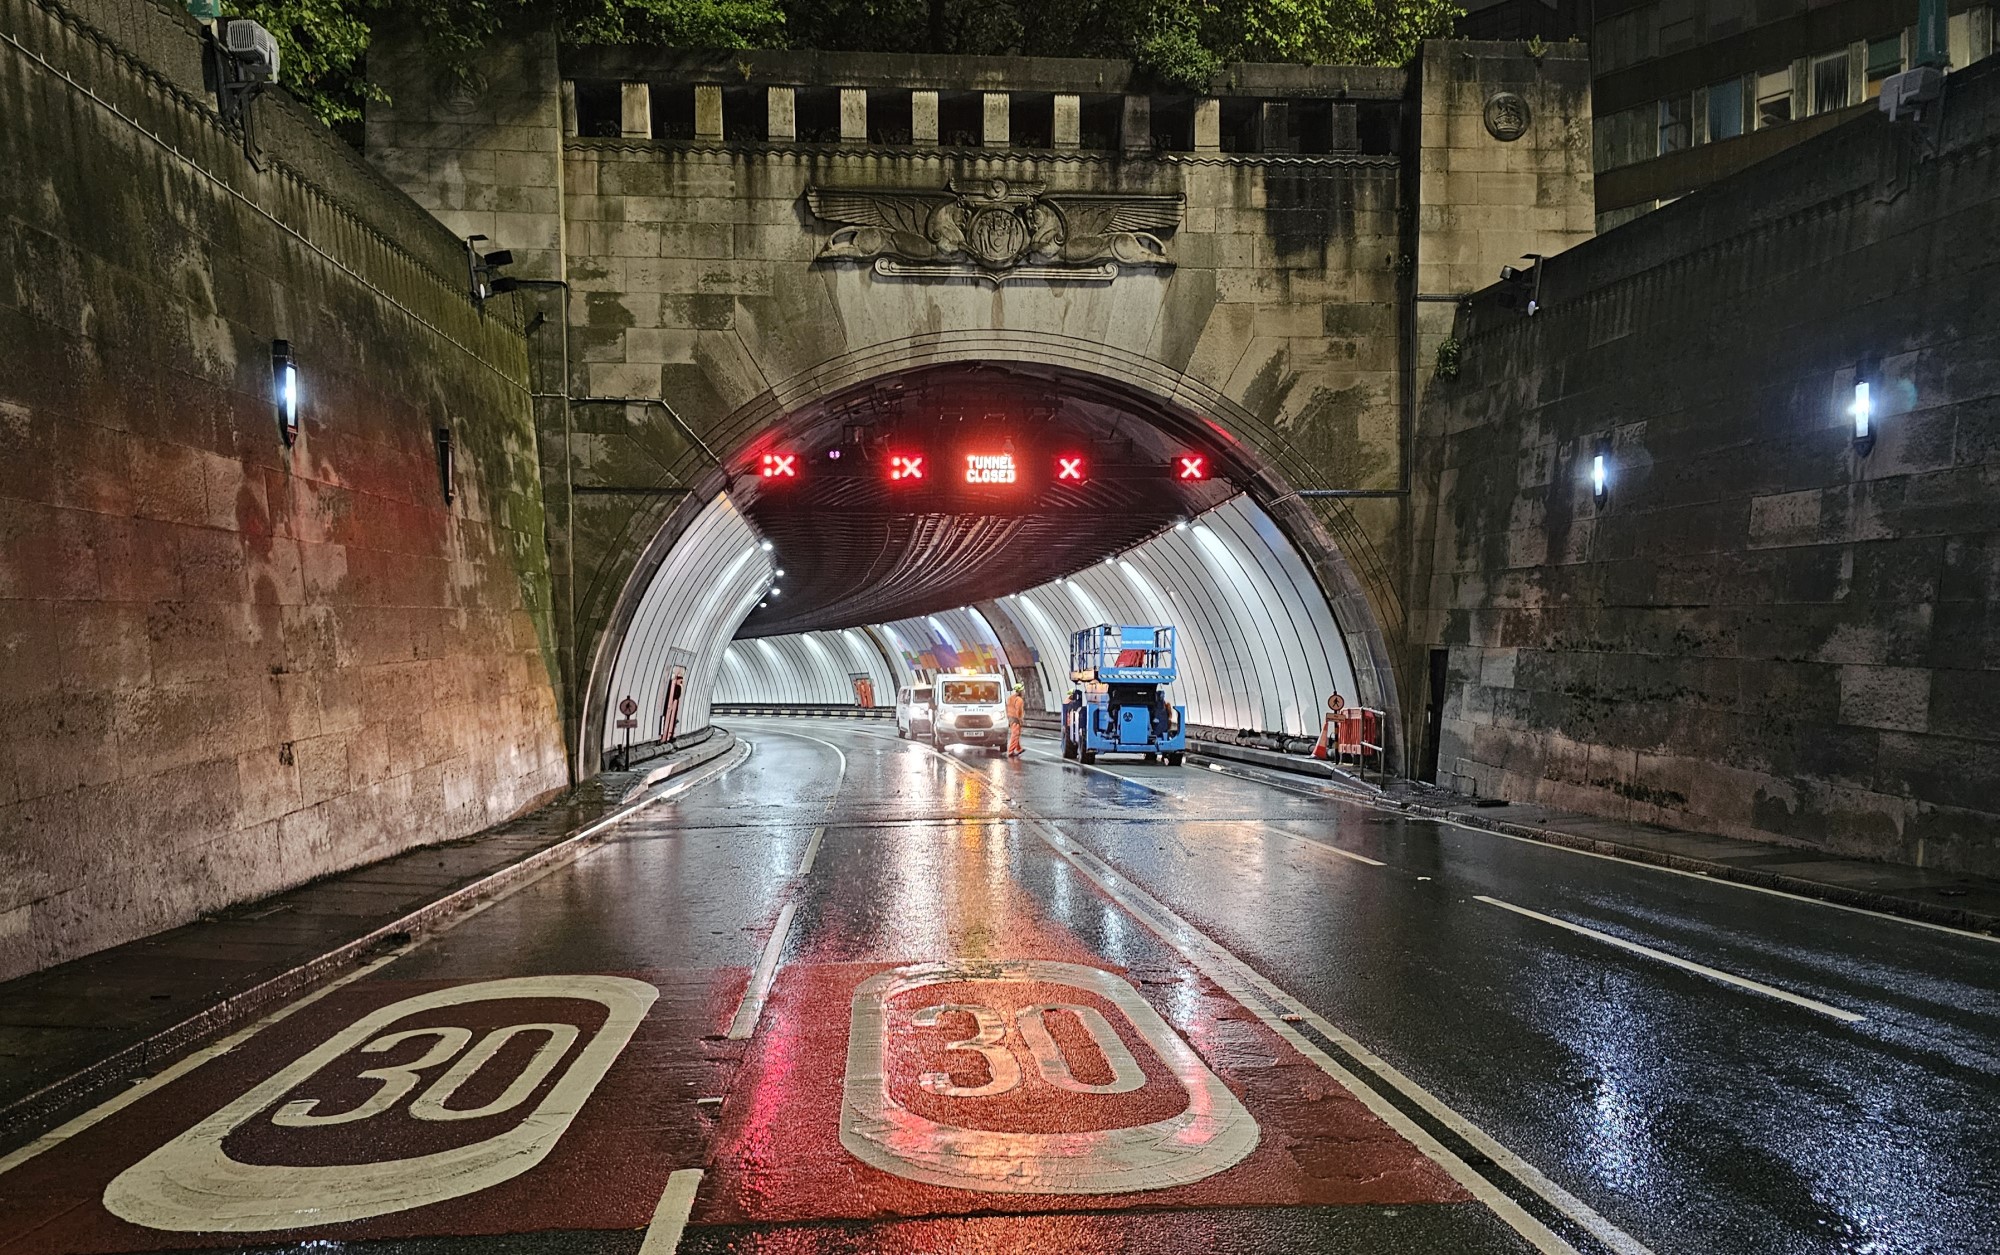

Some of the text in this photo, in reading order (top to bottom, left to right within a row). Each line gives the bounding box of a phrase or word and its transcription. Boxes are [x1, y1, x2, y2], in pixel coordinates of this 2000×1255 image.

[966, 455, 1015, 469] TUNNEL
[966, 469, 1016, 483] CLOSED
[271, 1022, 579, 1128] 30
[911, 1002, 1147, 1099] 30
